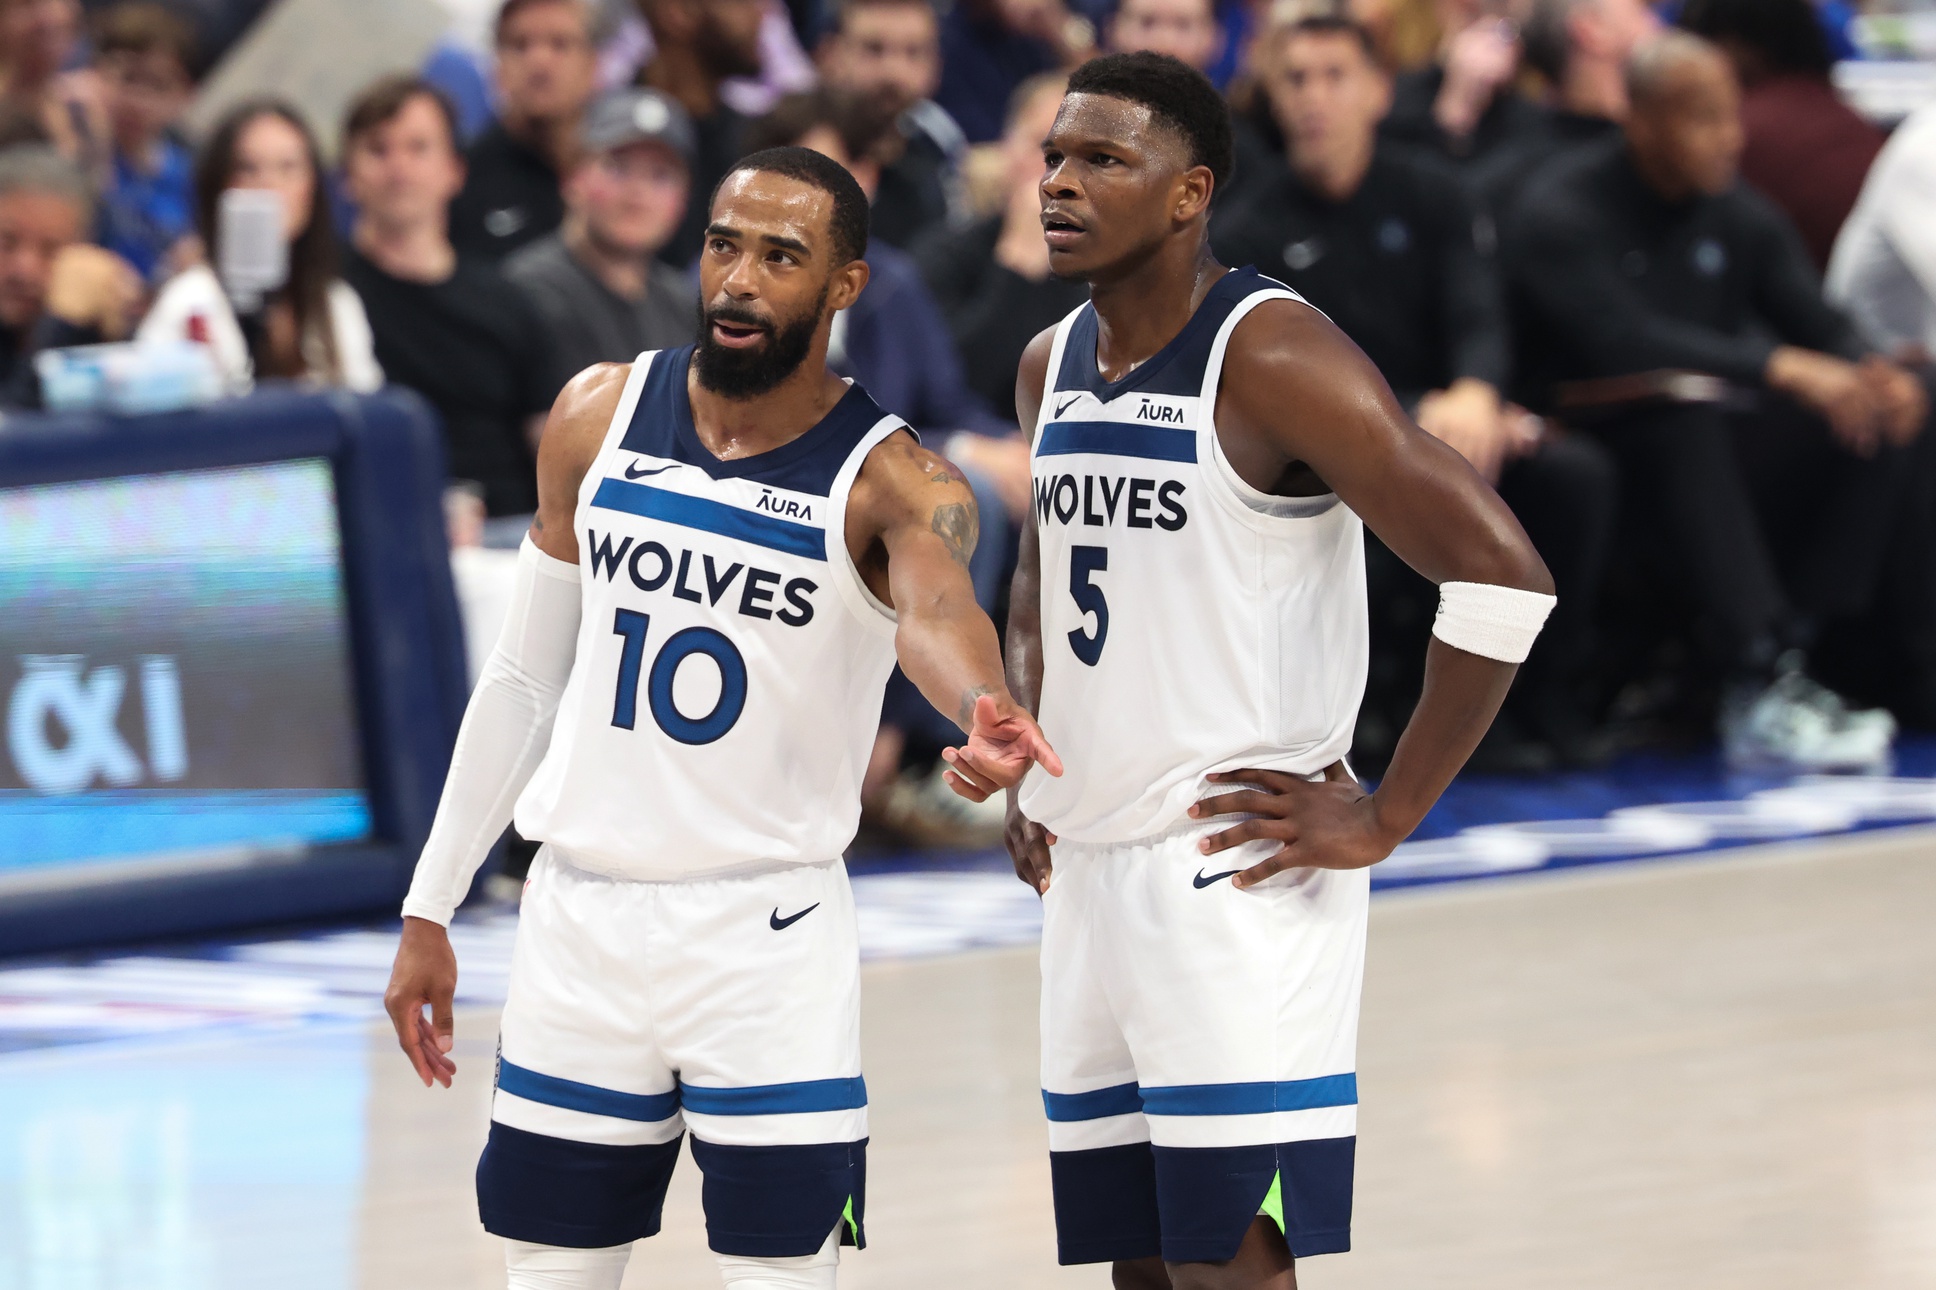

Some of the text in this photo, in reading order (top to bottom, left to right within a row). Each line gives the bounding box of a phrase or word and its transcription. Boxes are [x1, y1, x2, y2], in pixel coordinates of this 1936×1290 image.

[1034, 473, 1188, 532] WOLVES
[588, 528, 819, 628] WOLVES
[1067, 544, 1110, 667] 5
[610, 607, 748, 746] 10
